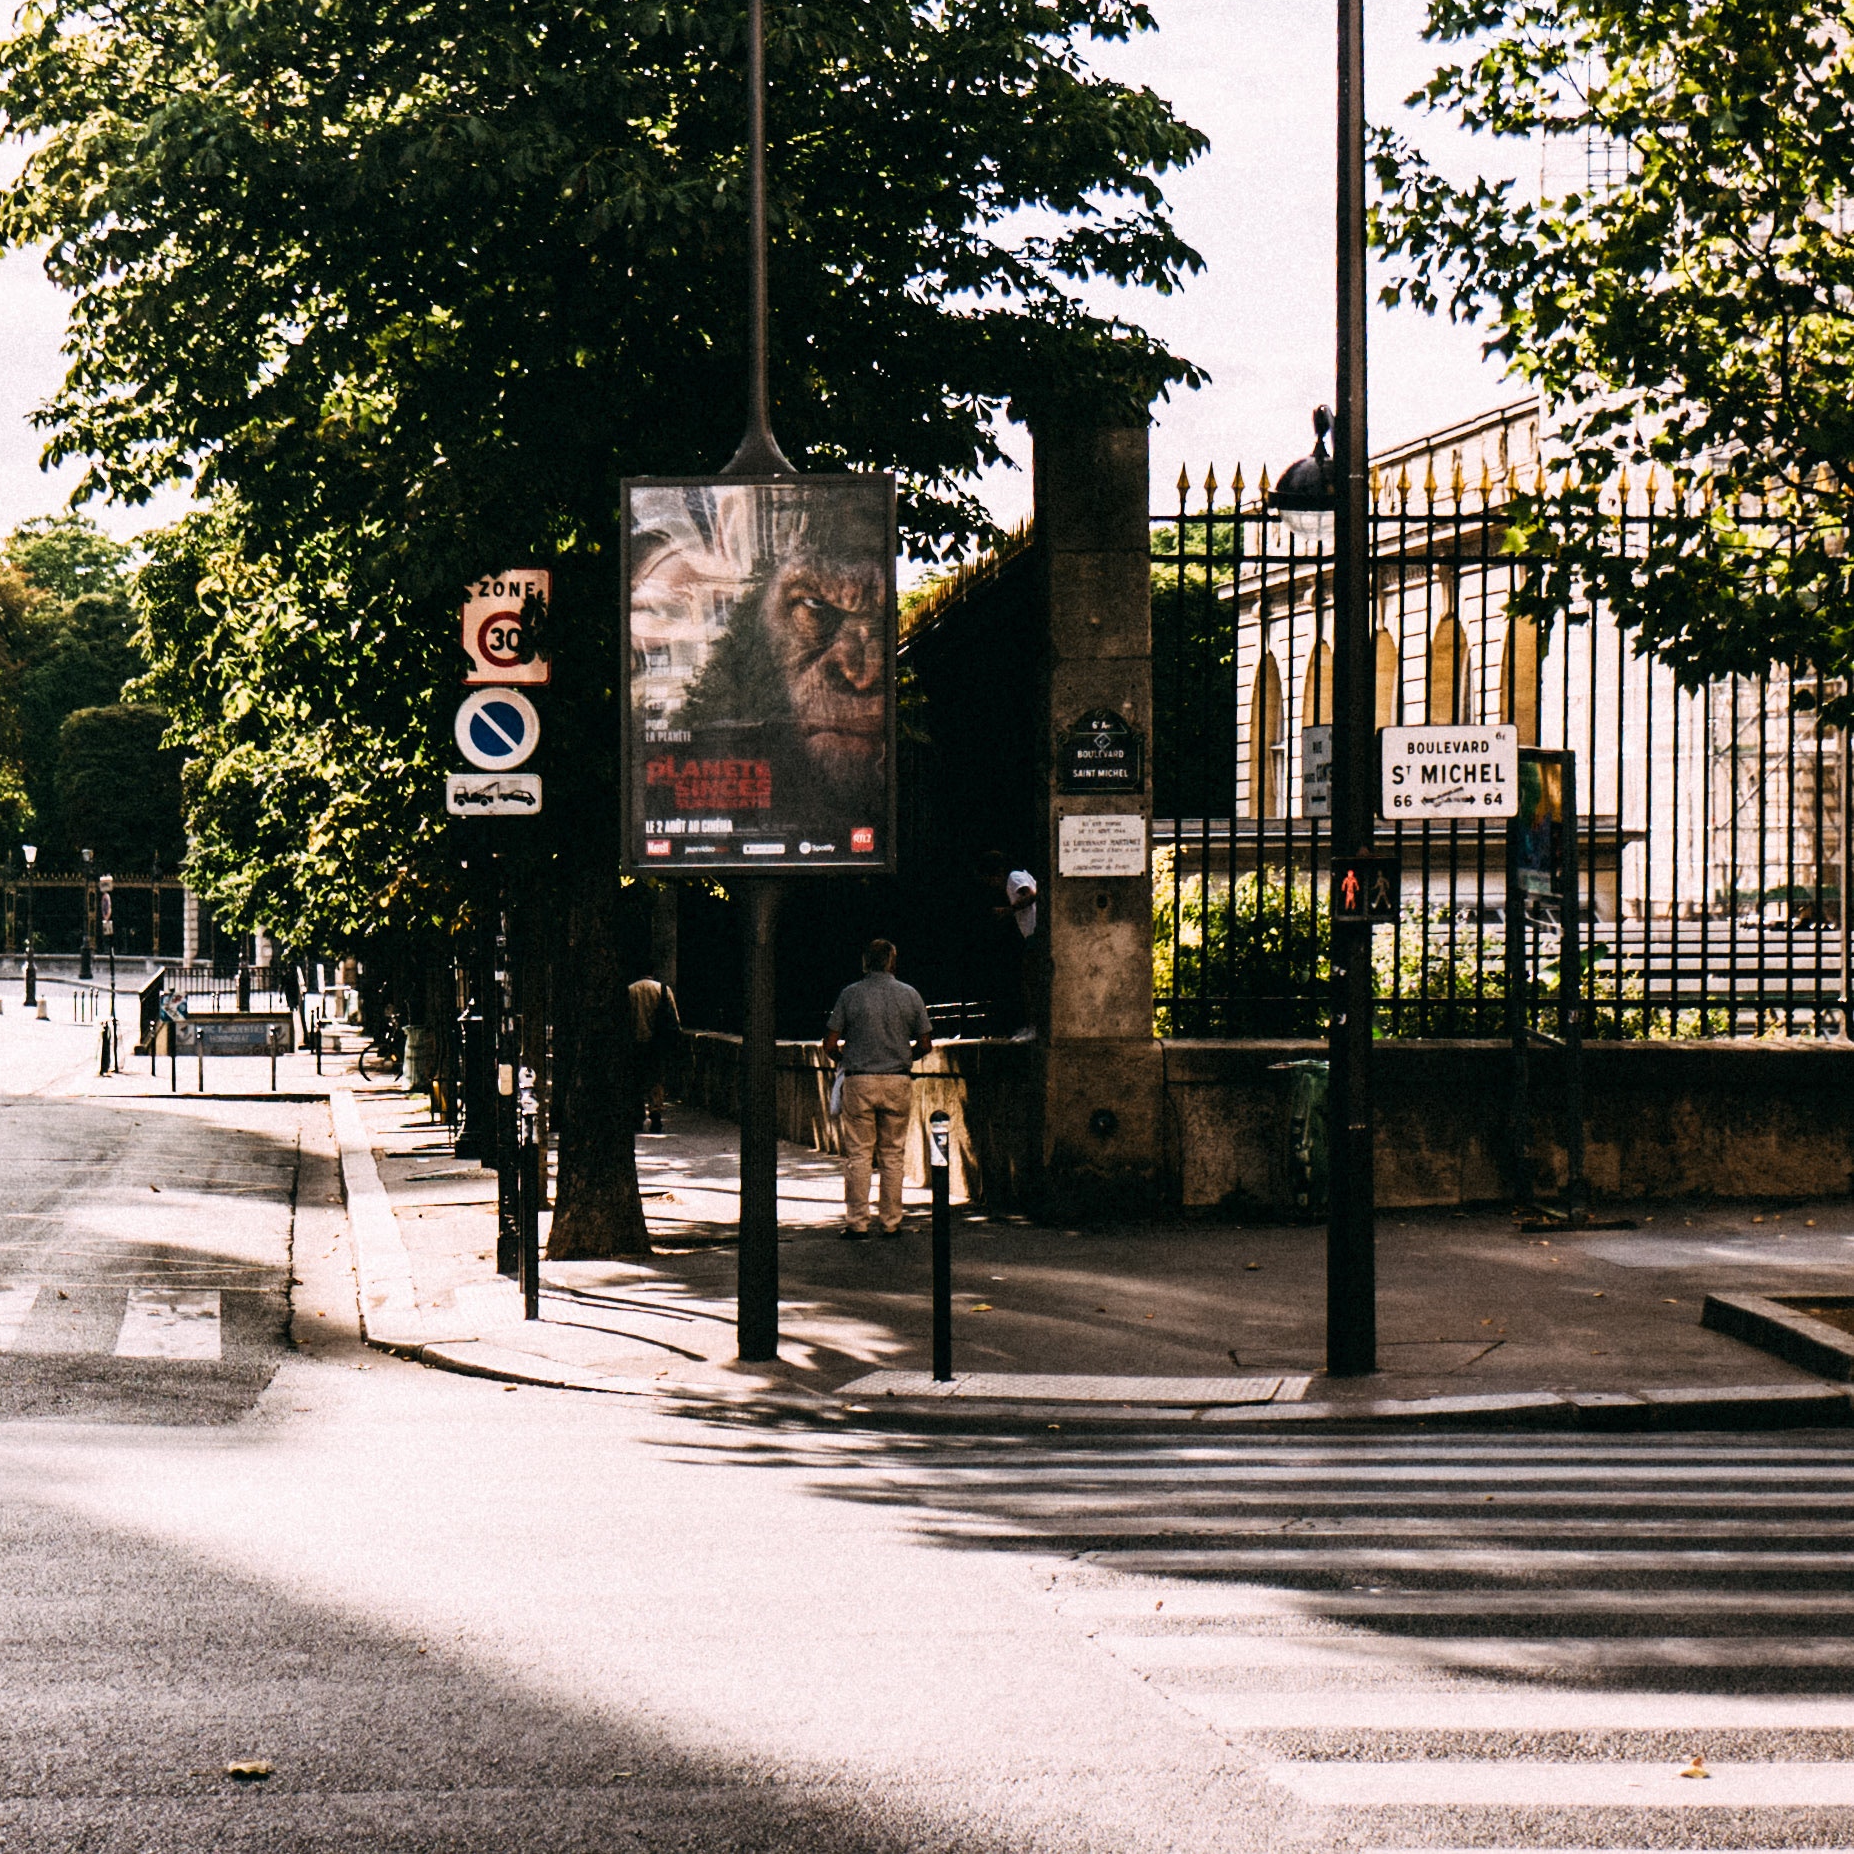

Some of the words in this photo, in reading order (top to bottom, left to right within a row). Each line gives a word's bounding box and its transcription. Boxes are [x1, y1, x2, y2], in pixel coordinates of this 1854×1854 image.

[479, 582, 535, 597] ZONE
[490, 628, 523, 651] 30
[1407, 740, 1490, 755] BOULEVARD
[1077, 750, 1125, 759] BOULEVARD
[1073, 769, 1096, 778] SAINT
[1098, 769, 1129, 778] MICHEL
[1421, 763, 1505, 784] MICHEL
[1393, 795, 1412, 808] 66
[1484, 793, 1503, 806] 64
[645, 820, 655, 833] LE
[656, 820, 663, 833] 2
[688, 820, 700, 833] AU
